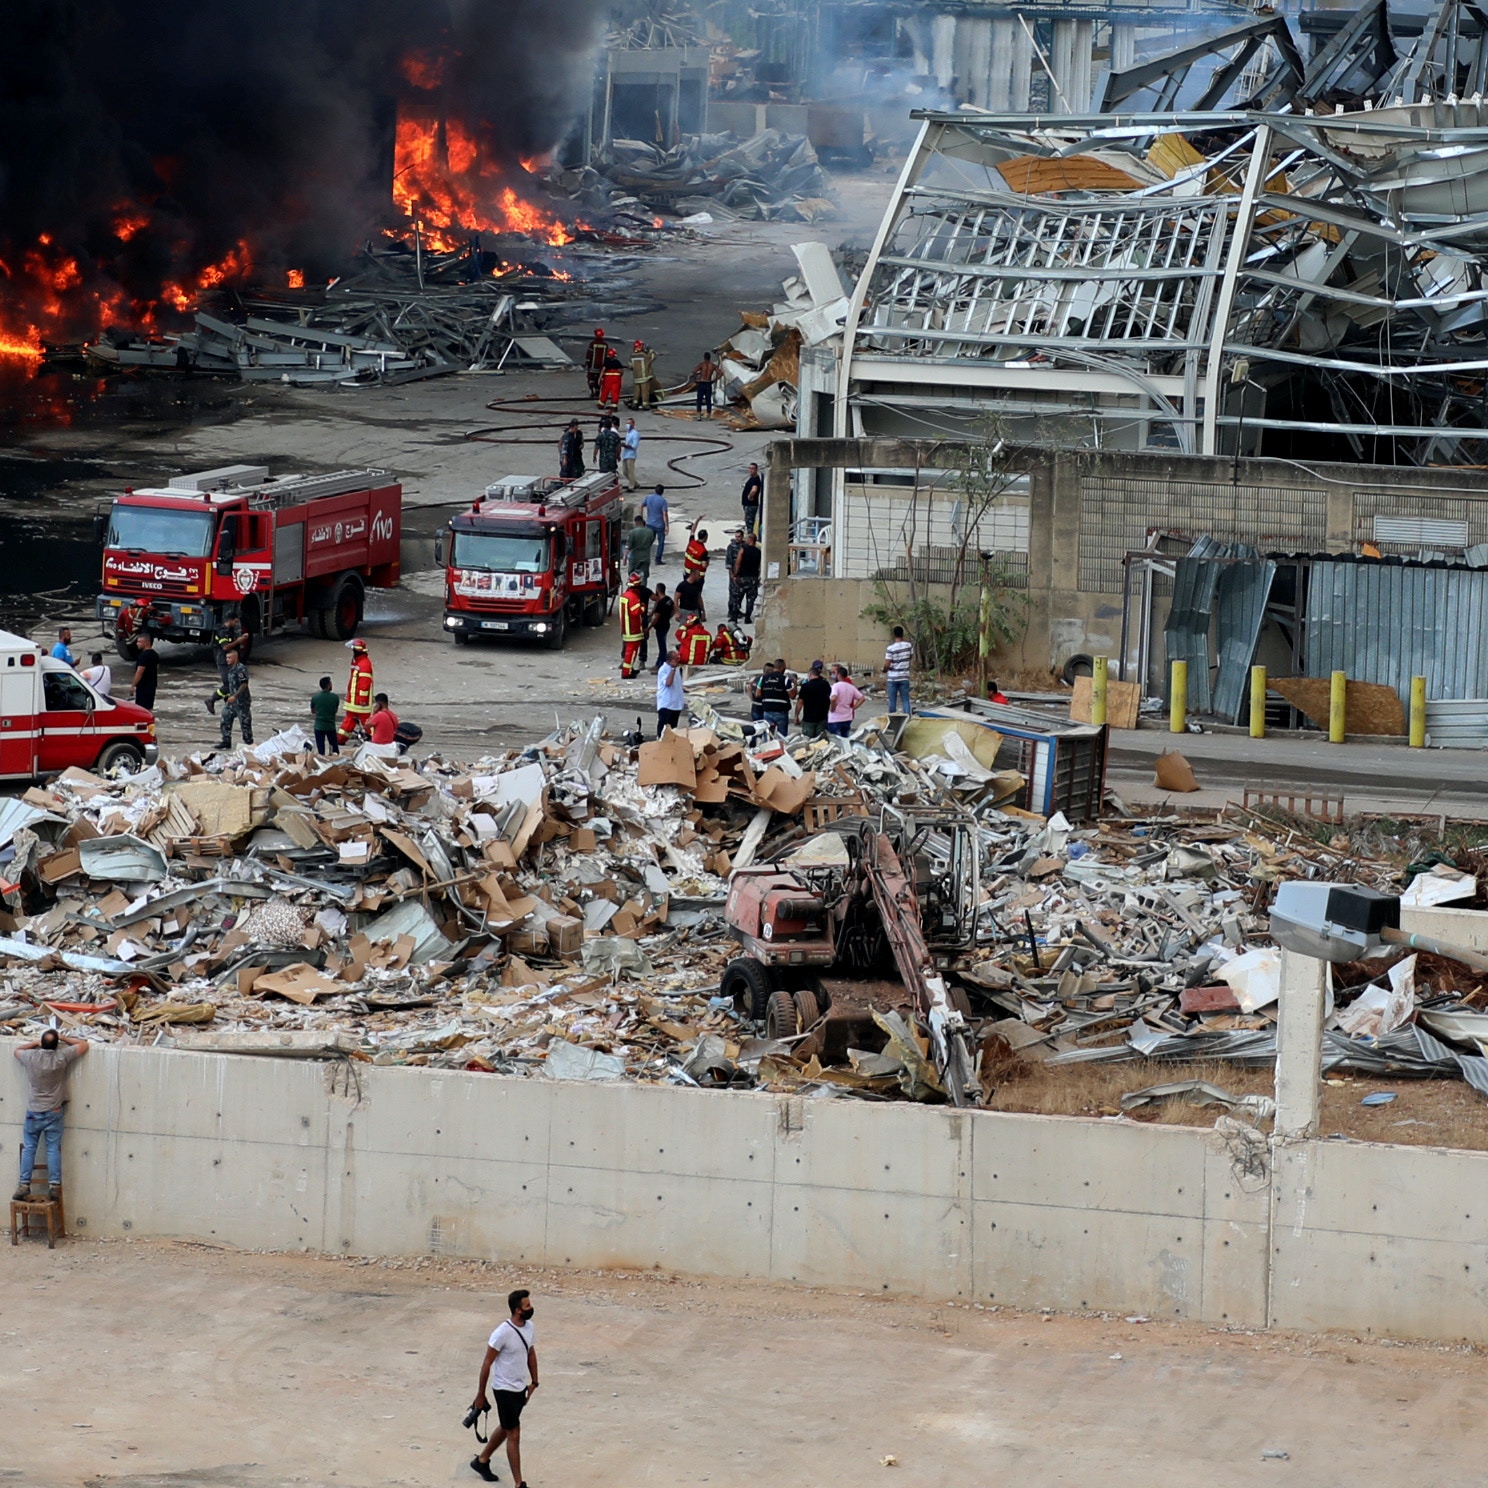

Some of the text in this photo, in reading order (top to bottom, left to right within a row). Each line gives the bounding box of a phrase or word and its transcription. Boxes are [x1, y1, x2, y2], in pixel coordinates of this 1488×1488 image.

[345, 518, 365, 539] فوج
[118, 562, 154, 574] الاطفاء
[154, 566, 187, 580] فوج
[141, 581, 163, 589] IVECO
